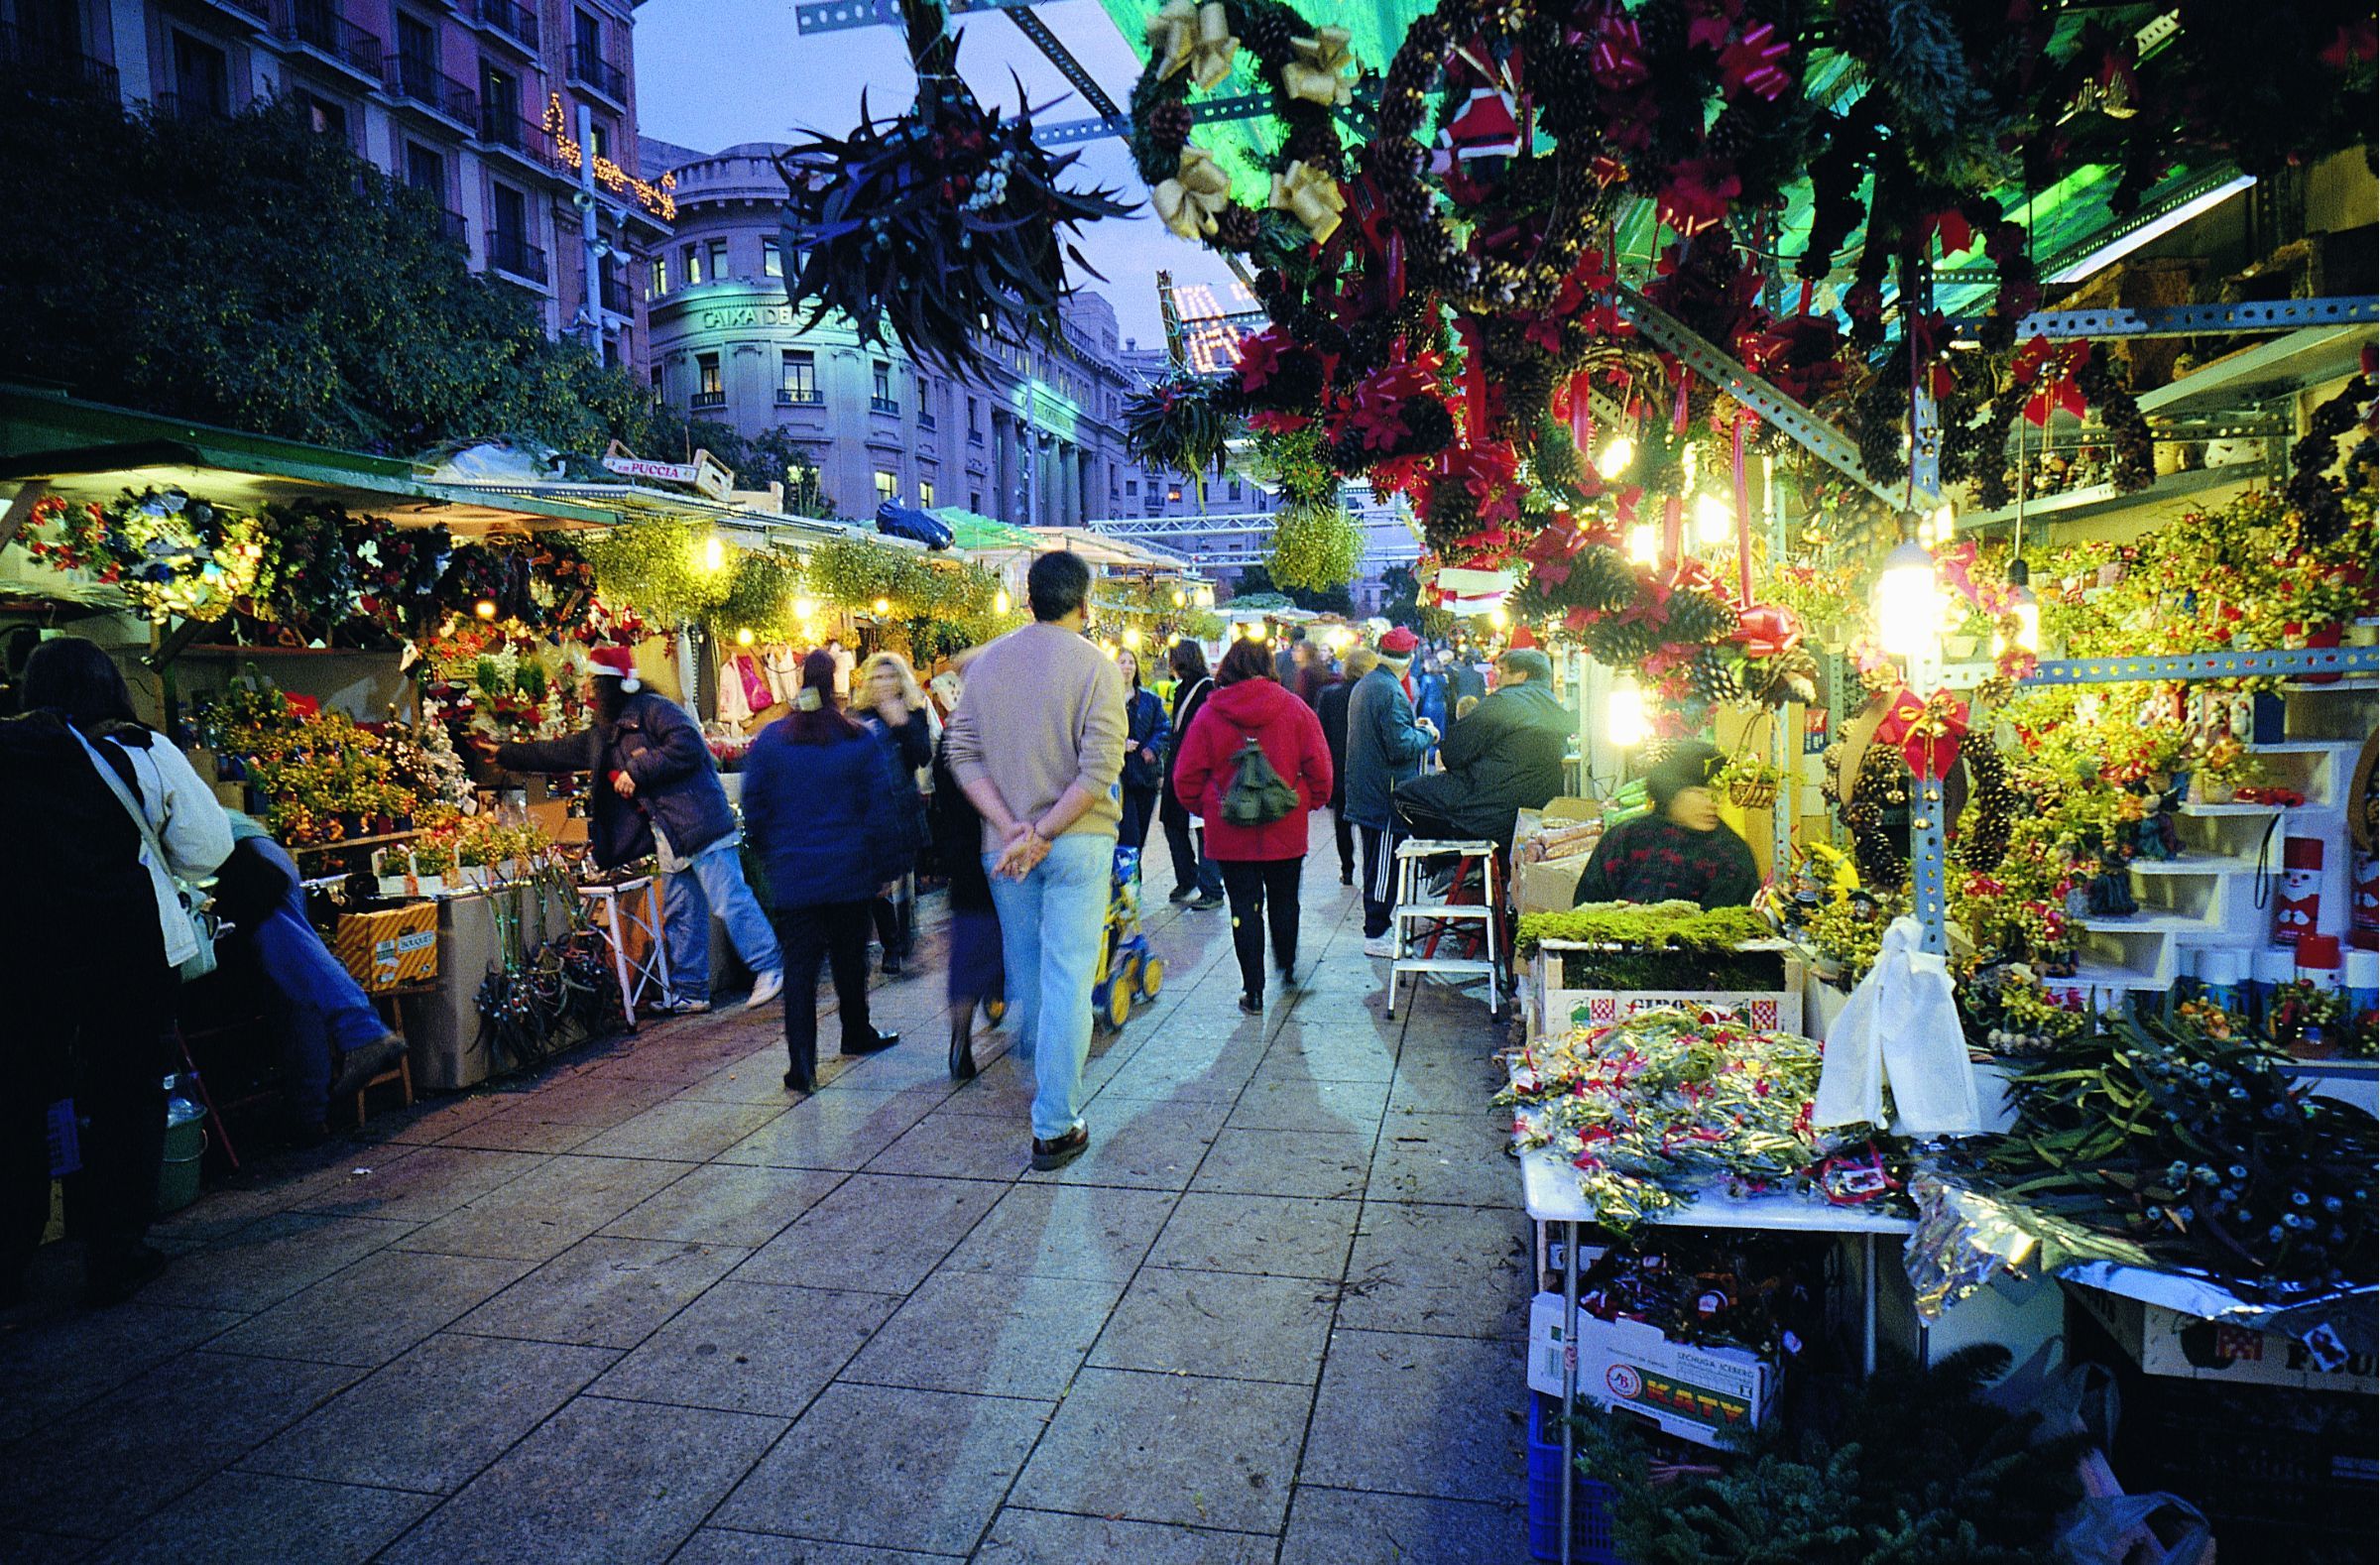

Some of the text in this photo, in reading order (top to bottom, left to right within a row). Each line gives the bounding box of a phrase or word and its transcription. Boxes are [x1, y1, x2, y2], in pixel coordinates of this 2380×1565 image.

[703, 306, 760, 328] CAIXA
[765, 306, 792, 325] DE
[632, 462, 679, 478] PUCCIA
[1677, 1351, 1716, 1369] LECHUGA
[1720, 1363, 1754, 1379] ICEBERG
[1644, 1379, 1745, 1424] KATY
